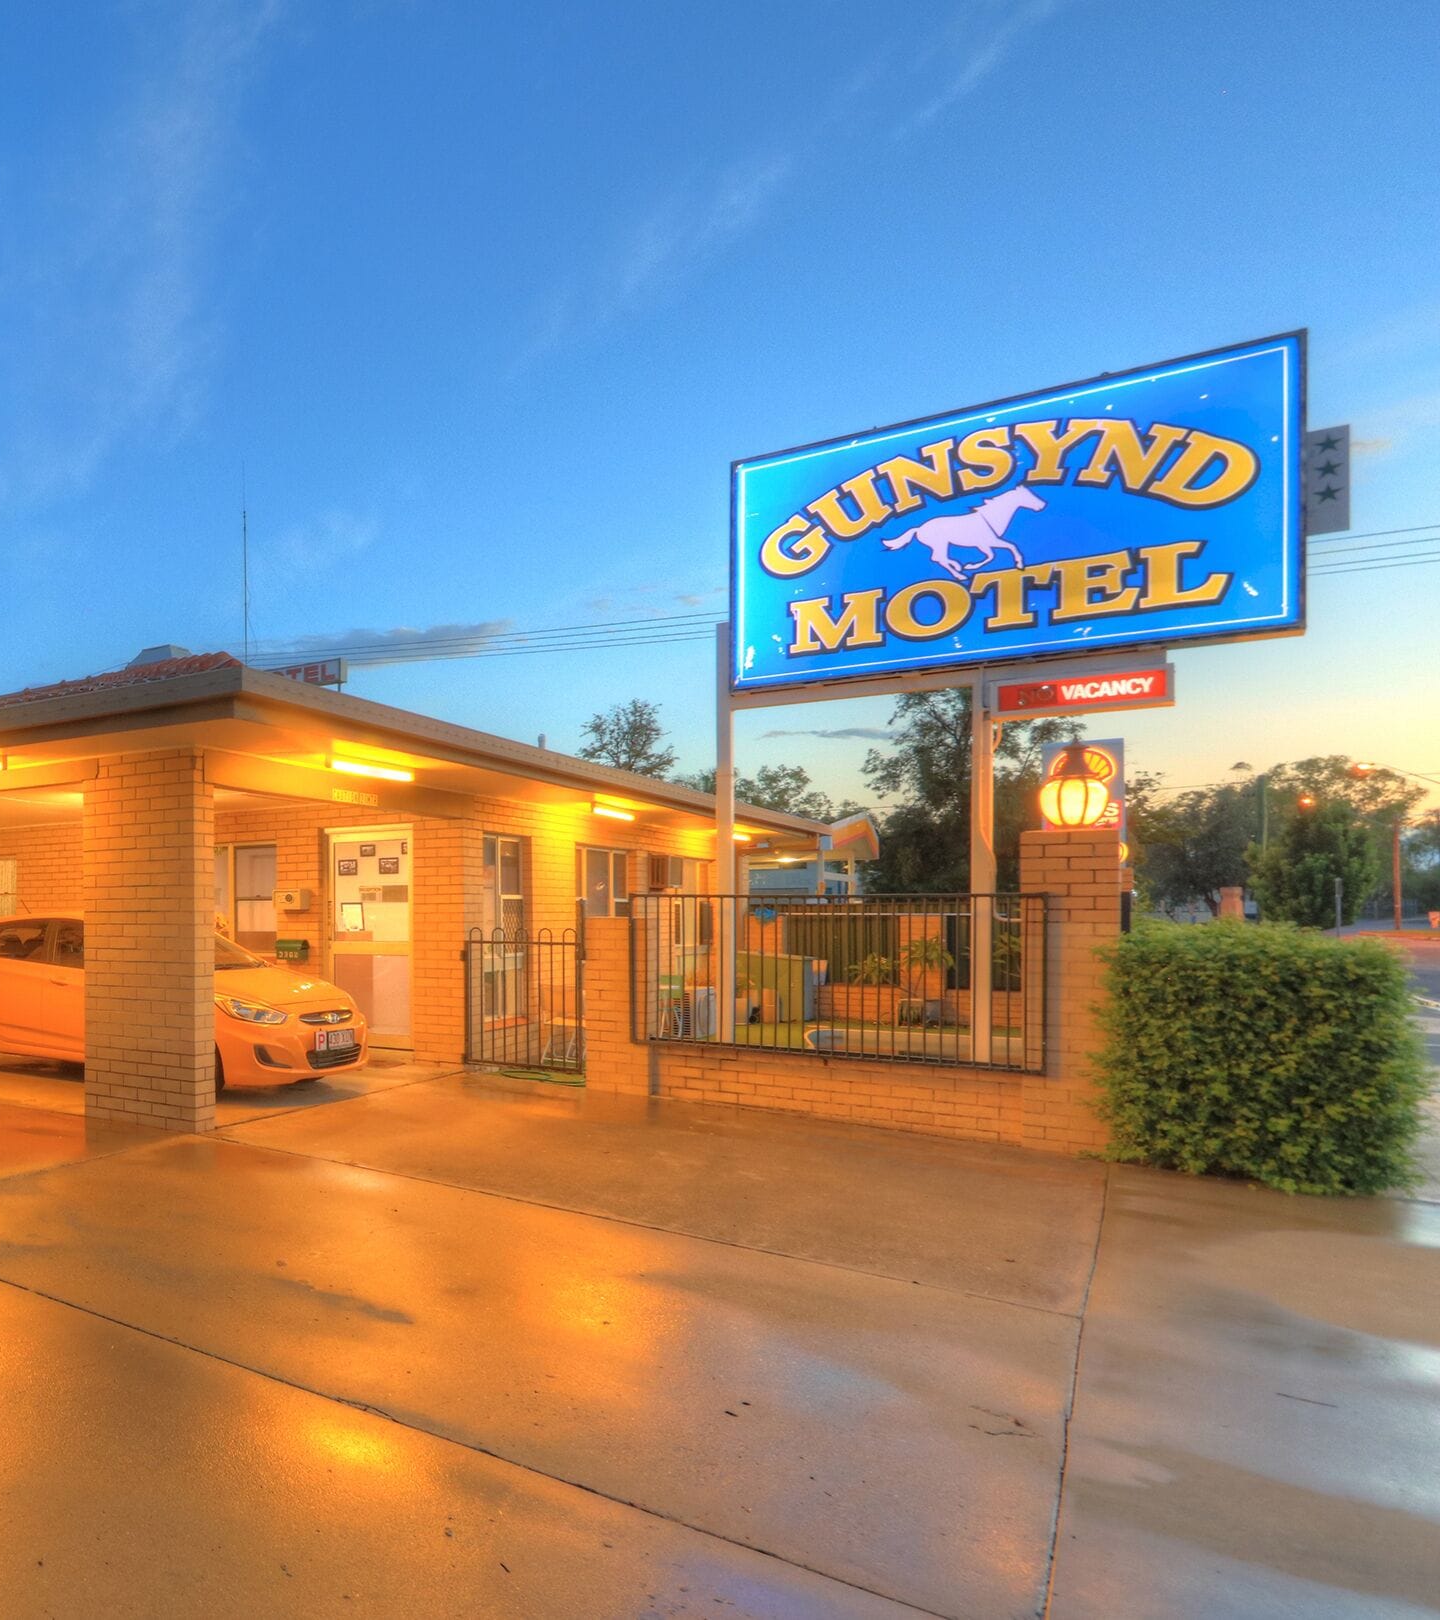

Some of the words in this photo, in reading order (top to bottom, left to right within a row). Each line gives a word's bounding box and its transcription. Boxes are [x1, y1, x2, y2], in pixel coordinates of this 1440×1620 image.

[760, 418, 1259, 577] GUNSYND
[788, 540, 1231, 656] MOTEL
[274, 663, 336, 682] TEL
[1061, 676, 1154, 700] VACANCY
[318, 1033, 326, 1050] P
